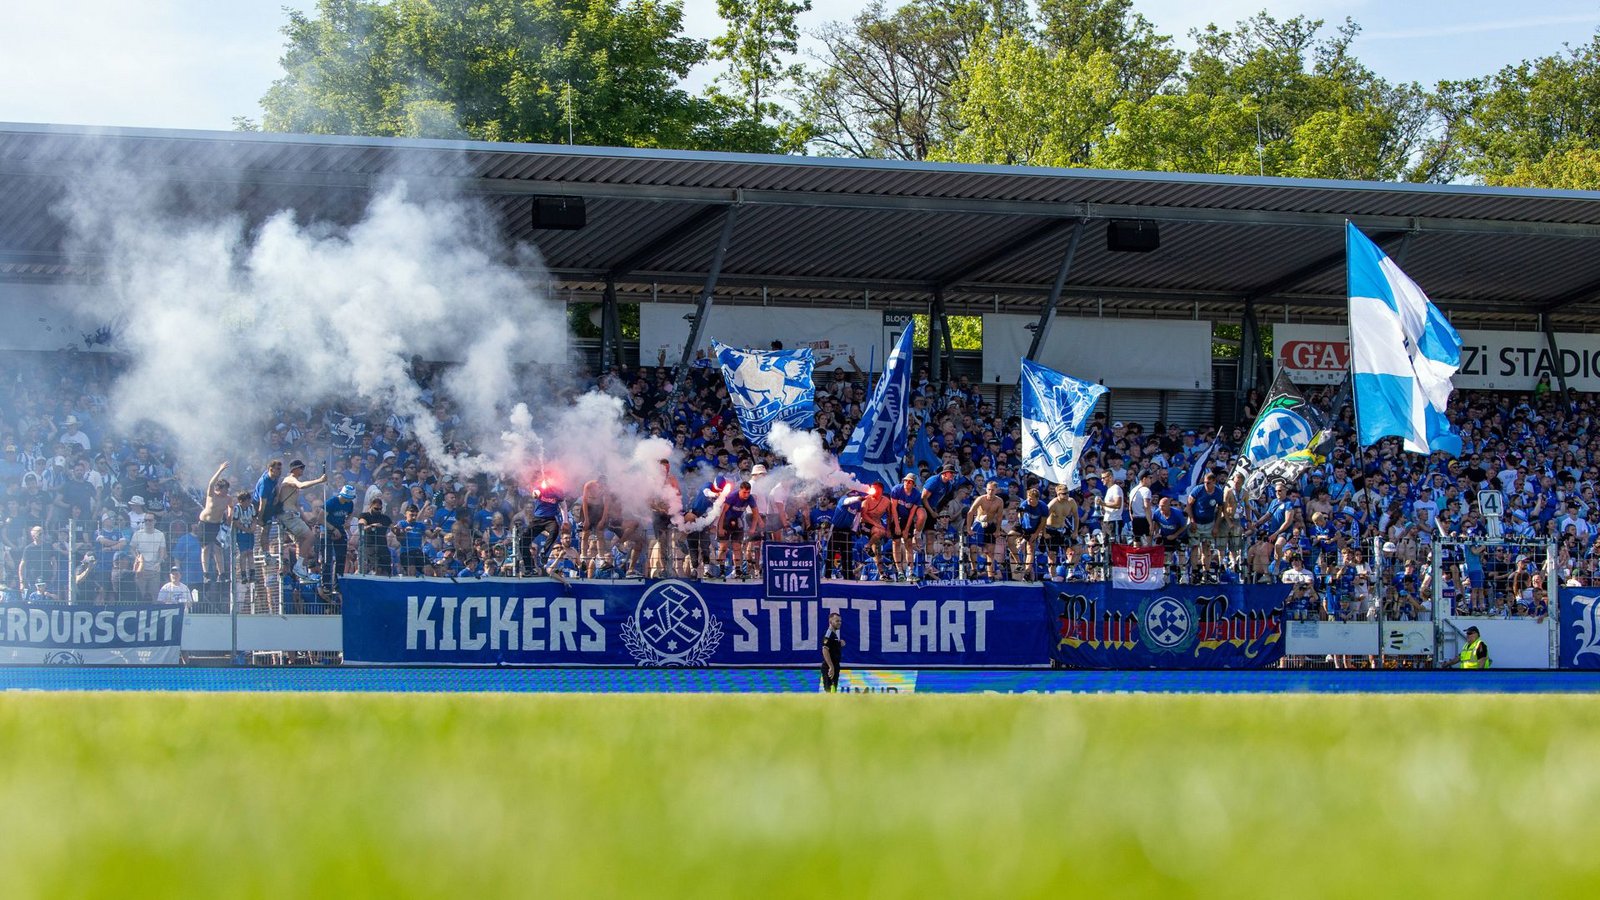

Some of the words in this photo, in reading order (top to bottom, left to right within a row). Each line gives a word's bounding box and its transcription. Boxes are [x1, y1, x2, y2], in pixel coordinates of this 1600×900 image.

[885, 315, 910, 323] BLOCK
[1292, 343, 1348, 369] GA
[1484, 494, 1498, 513] 4
[784, 549, 799, 558] FC
[774, 573, 809, 592] LINZ
[406, 596, 606, 652] KICKERS
[732, 598, 994, 652] STUTTGART
[1057, 592, 1139, 651] Blue
[1195, 595, 1283, 658] Boys
